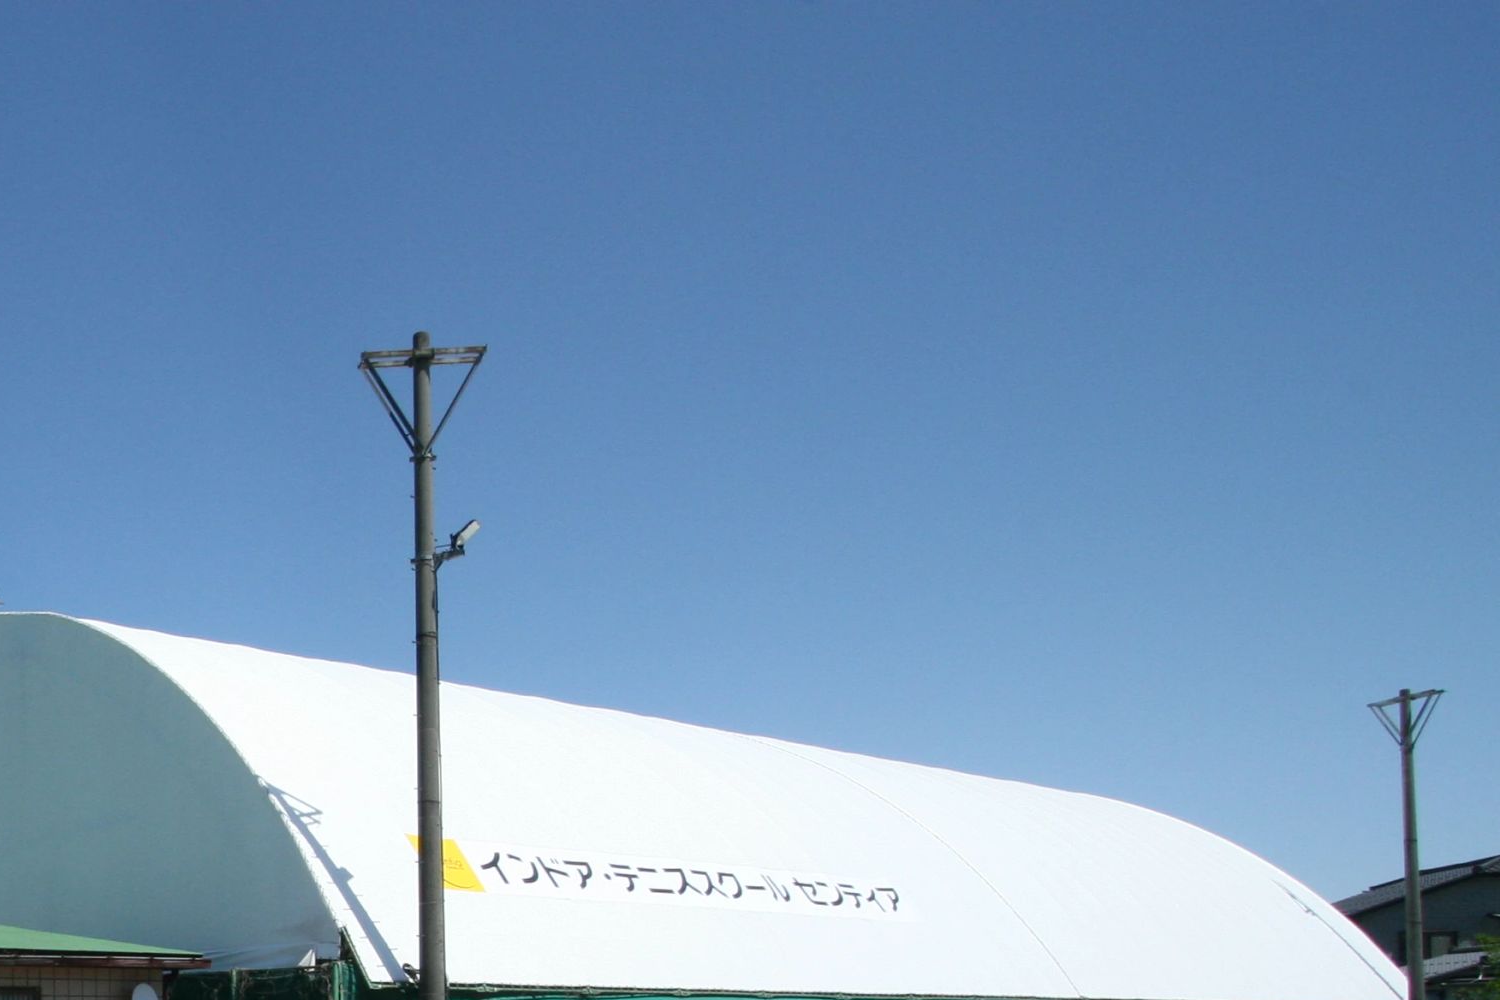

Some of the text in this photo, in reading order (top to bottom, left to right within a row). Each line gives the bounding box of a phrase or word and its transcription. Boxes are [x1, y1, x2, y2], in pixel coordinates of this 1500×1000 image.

[792, 877, 899, 912] センティア
